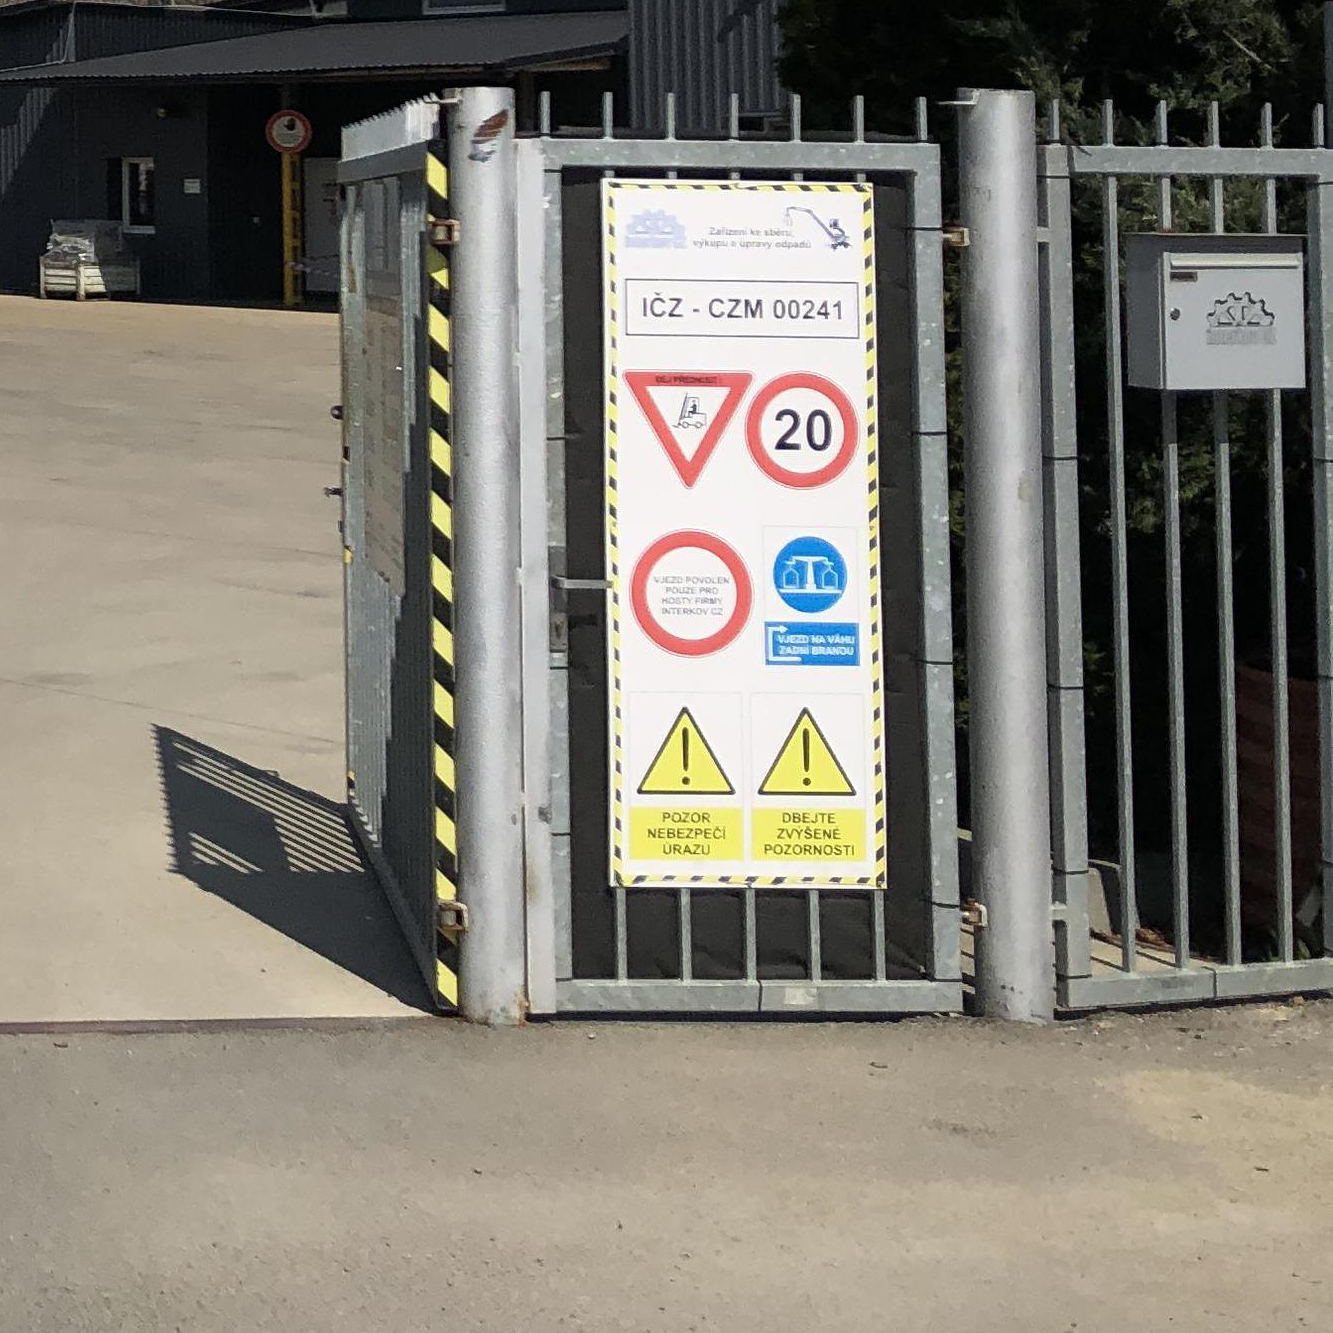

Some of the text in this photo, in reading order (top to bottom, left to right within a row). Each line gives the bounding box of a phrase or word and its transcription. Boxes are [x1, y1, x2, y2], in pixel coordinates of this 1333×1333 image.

[642, 292, 683, 319] IČZ
[709, 298, 763, 319] CZM
[773, 299, 844, 320] 00241
[774, 409, 833, 451] 20
[666, 586, 719, 595] POUZE PRO
[661, 597, 723, 605] HOSTY FIRMY
[661, 607, 724, 616] INTERKOV CZ
[661, 812, 711, 824] POZOR
[781, 812, 836, 824] DBEJTE
[647, 824, 726, 840] NEBEZPEČÍ
[776, 824, 841, 840] ZVÝŠENÉ
[764, 844, 855, 856] POZORNOSTI
